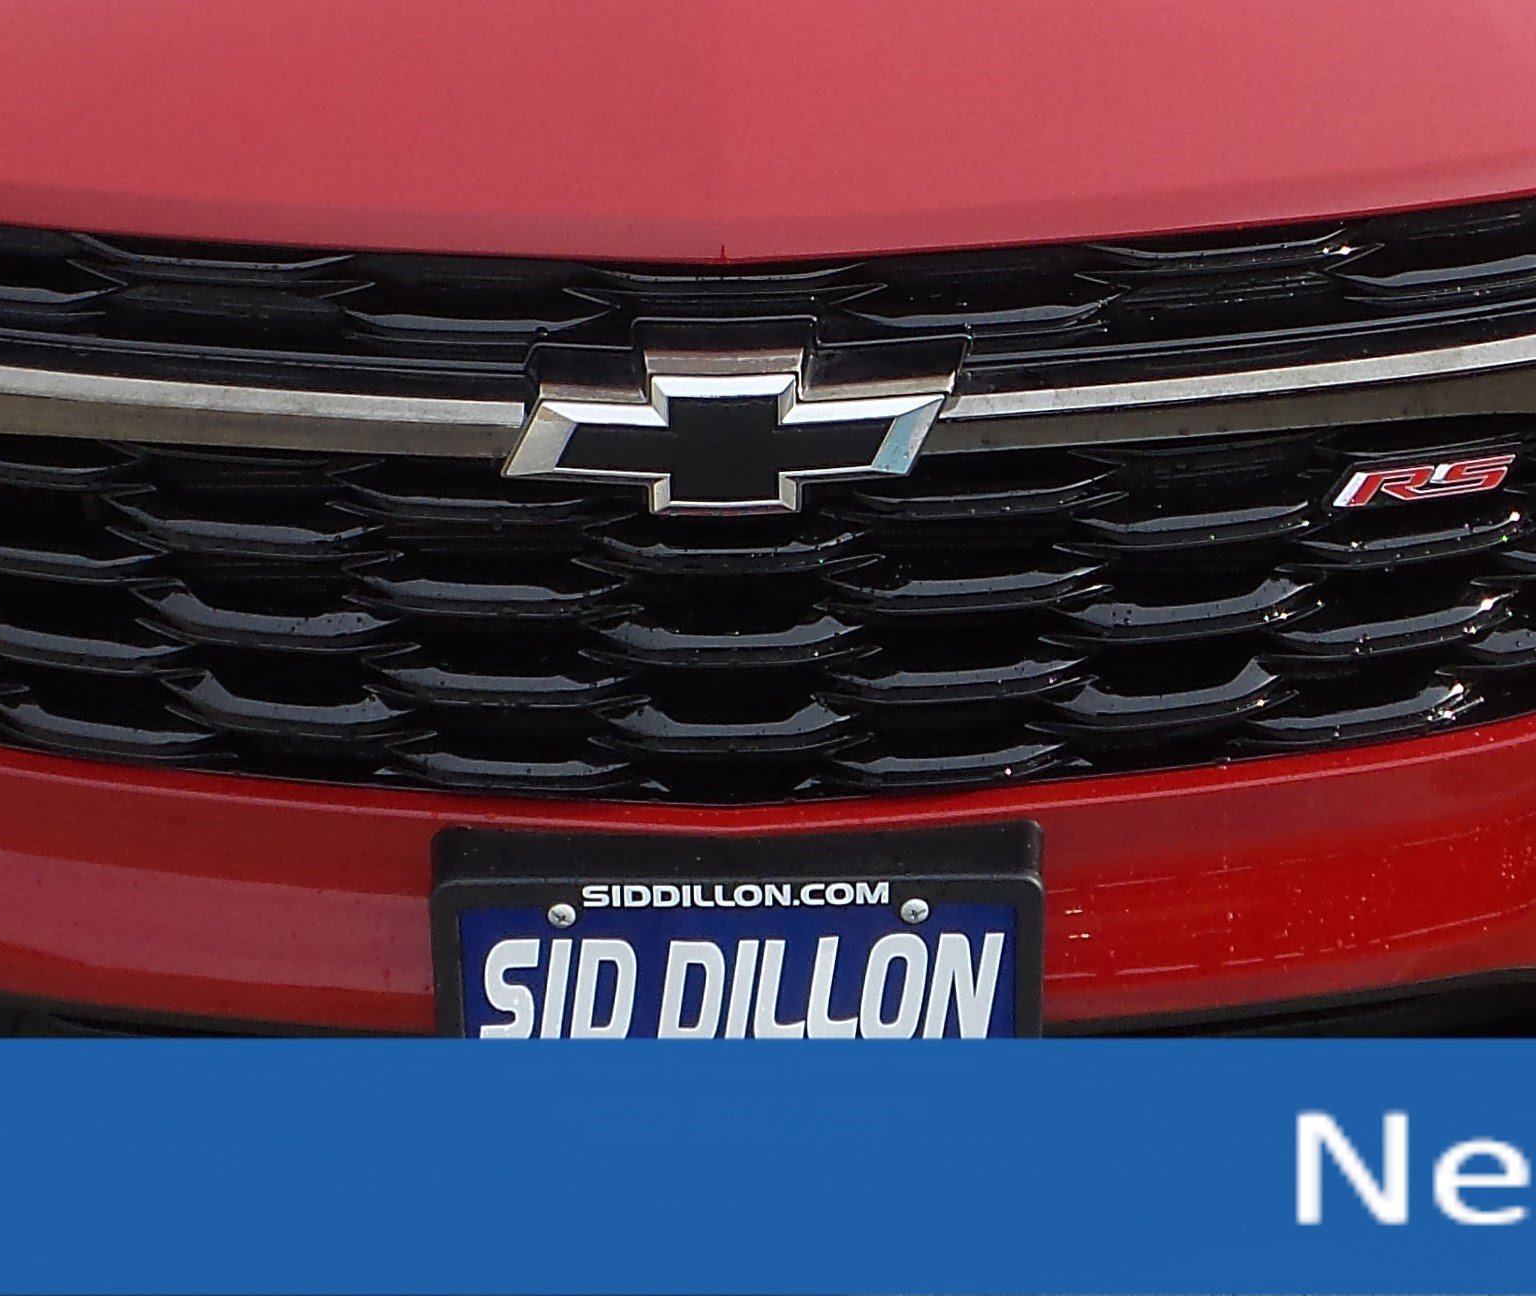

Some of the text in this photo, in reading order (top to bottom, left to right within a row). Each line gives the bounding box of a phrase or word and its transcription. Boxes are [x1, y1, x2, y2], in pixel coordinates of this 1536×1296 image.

[1332, 453, 1516, 508] RS
[582, 881, 891, 908] SIDDILLON.COM
[479, 932, 1005, 1039] SID DILLON
